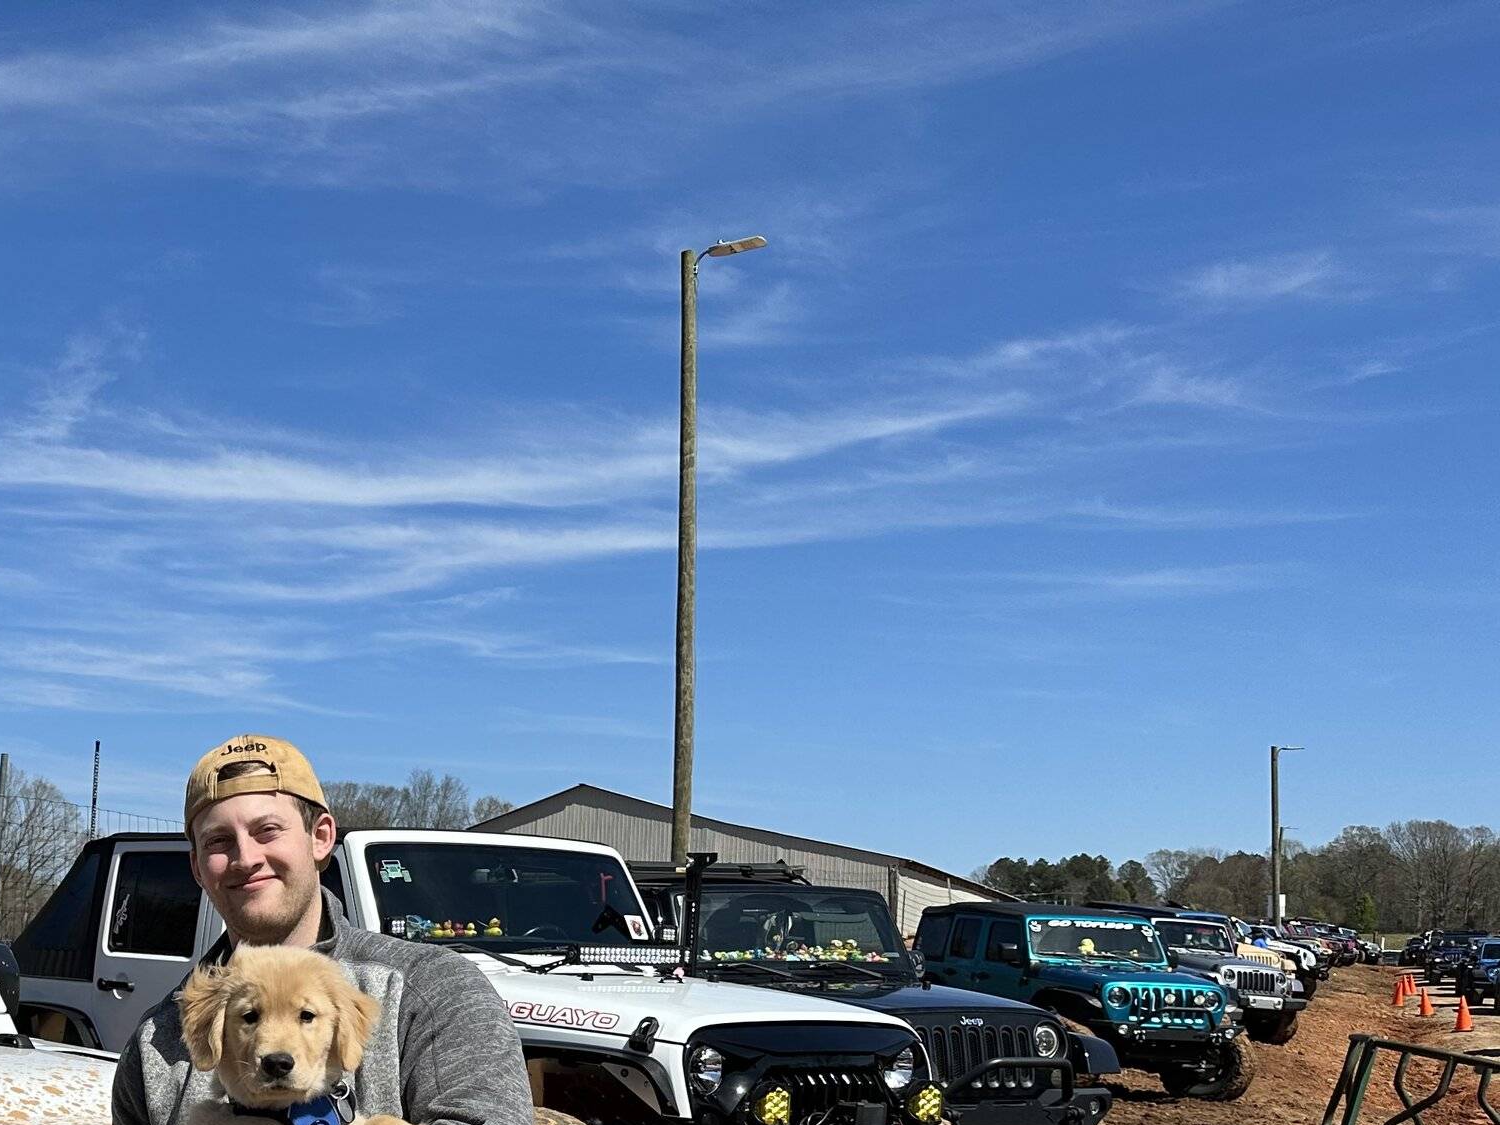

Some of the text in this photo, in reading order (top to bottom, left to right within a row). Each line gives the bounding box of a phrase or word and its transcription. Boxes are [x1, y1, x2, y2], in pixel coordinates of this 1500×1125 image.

[220, 742, 267, 756] Jeep
[502, 1000, 620, 1030] GUAYO
[959, 1016, 984, 1027] Jeep
